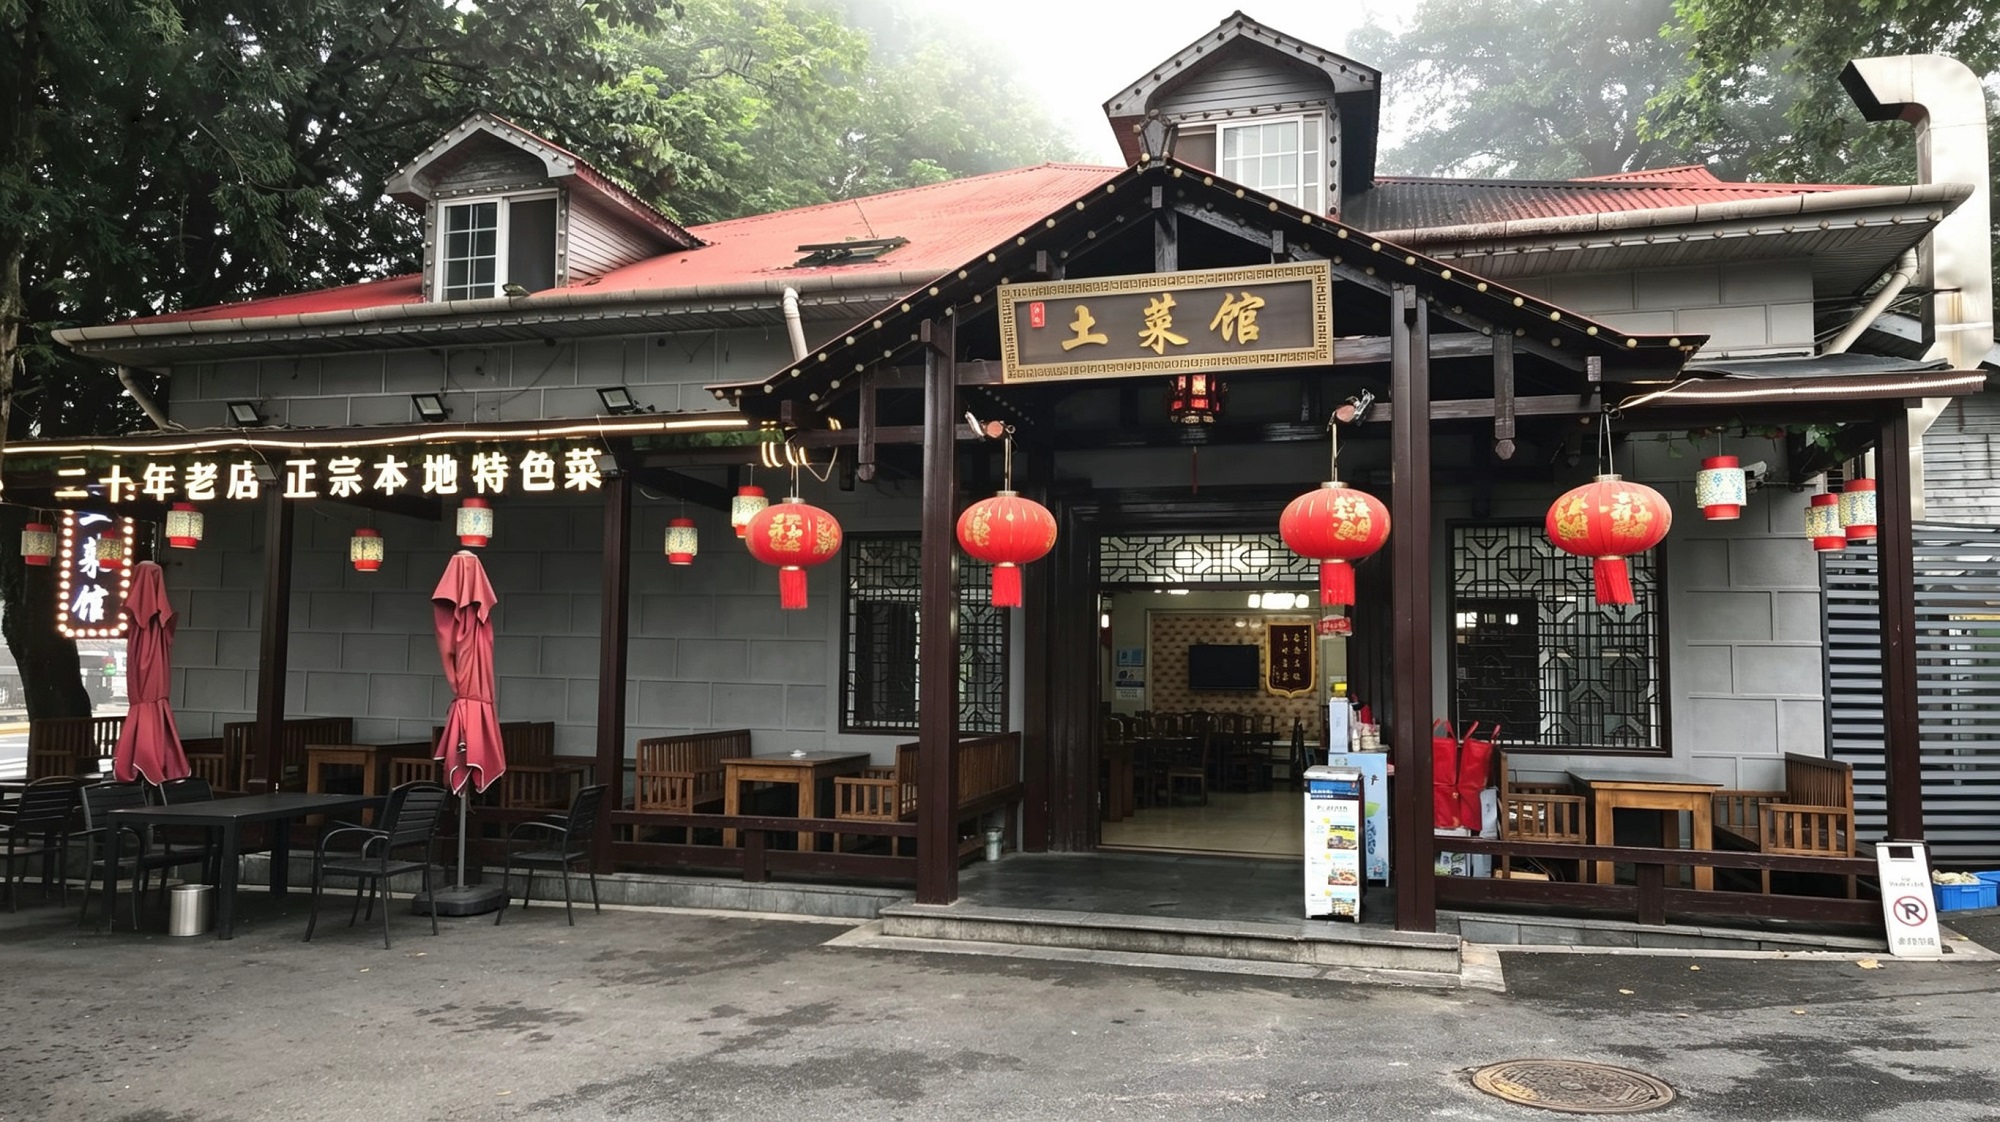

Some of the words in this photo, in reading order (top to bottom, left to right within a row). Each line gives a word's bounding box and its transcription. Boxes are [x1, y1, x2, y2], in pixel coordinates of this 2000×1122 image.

[1061, 292, 1265, 354] 土菜馆
[283, 448, 602, 498] 正宗本地特色菜
